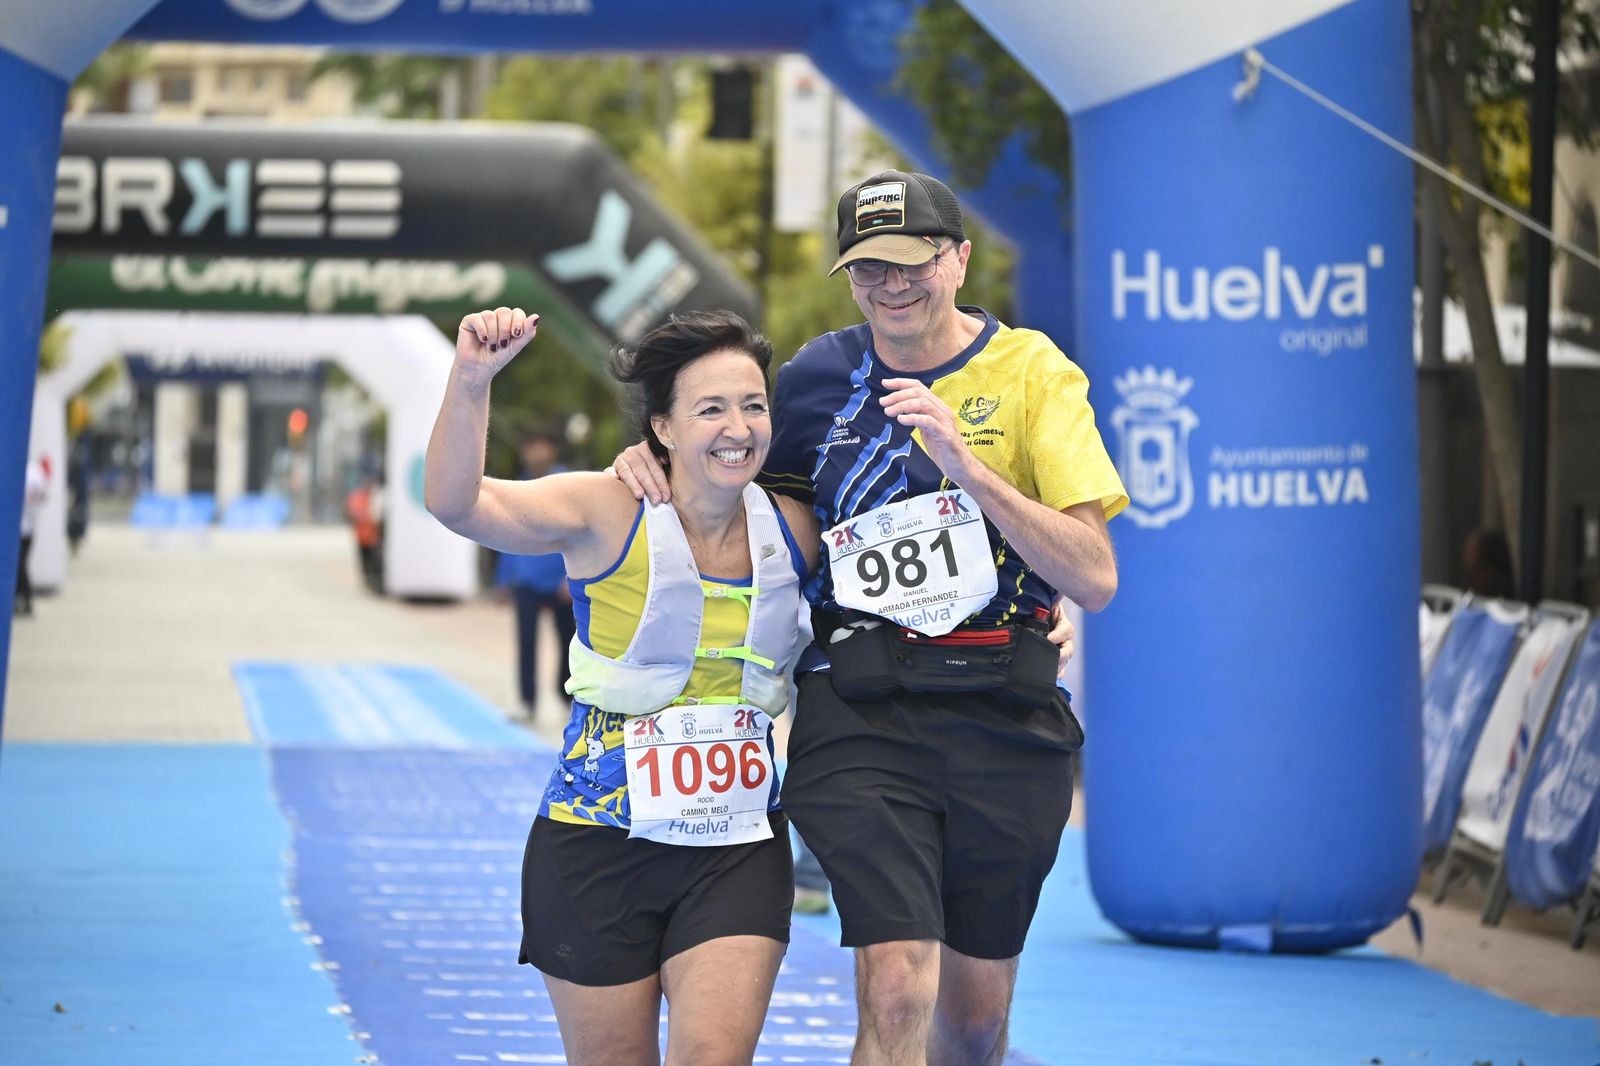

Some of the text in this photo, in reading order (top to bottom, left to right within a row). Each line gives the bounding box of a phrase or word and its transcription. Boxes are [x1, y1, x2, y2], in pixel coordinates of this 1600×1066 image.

[858, 193, 900, 208] SURFING
[1279, 325, 1368, 354] original
[1209, 443, 1369, 470] Ayuntamiento de
[1208, 468, 1370, 508] HUELVA
[936, 493, 970, 516] 21K
[897, 519, 923, 532] HUELVA
[940, 512, 972, 526] HUELVA
[831, 521, 864, 548] 21K
[836, 539, 866, 557] HUELVA
[856, 529, 959, 598] 981
[877, 590, 959, 615] ARMADA FERNANDEZ
[903, 587, 928, 597] MANUEL
[633, 714, 664, 736] 21K
[734, 709, 762, 730] 21K
[633, 734, 666, 746] HUELVA
[734, 728, 760, 738] HUELVA
[636, 741, 767, 797] 1096
[697, 796, 715, 804] ROCIO
[681, 805, 729, 817] CAMINO MELO
